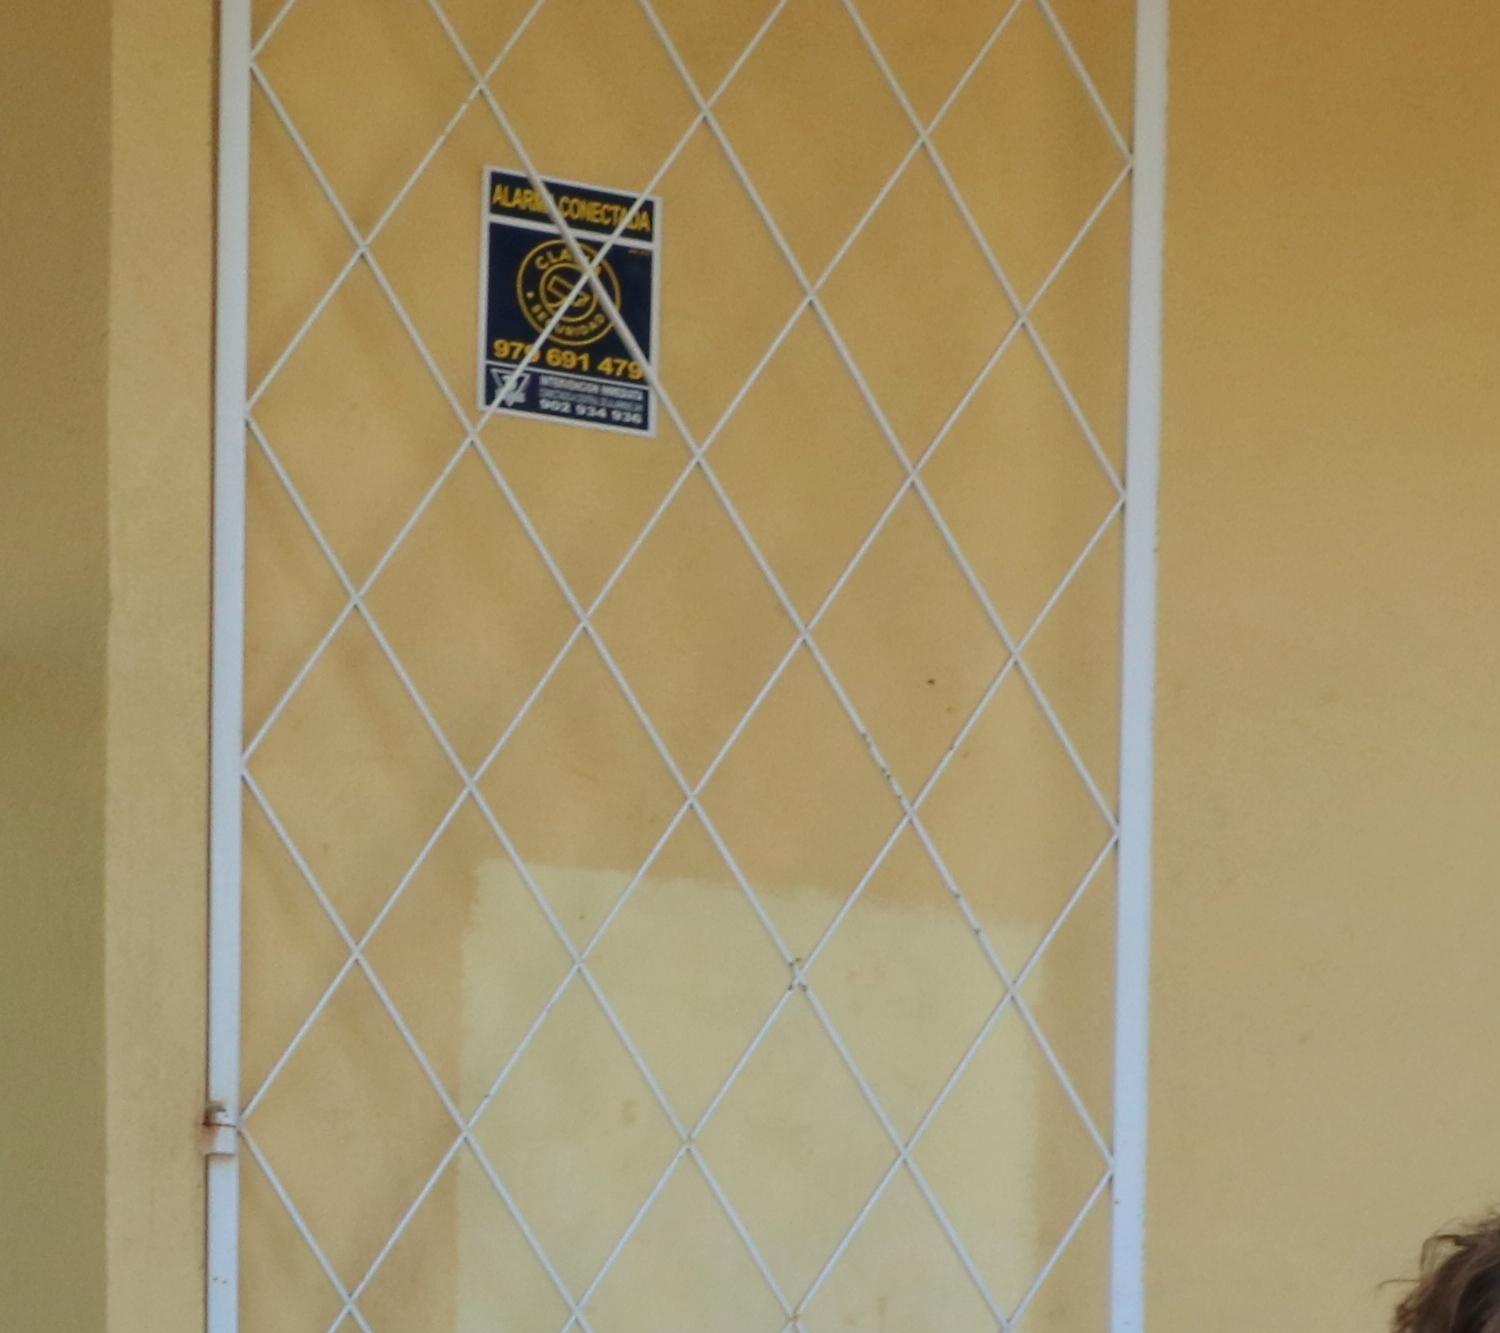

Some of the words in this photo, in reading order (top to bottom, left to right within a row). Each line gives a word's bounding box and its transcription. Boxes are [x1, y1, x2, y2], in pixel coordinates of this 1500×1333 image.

[493, 184, 557, 215] ALARM
[546, 348, 590, 371] 691
[597, 356, 643, 380] 479
[539, 399, 572, 413] 902
